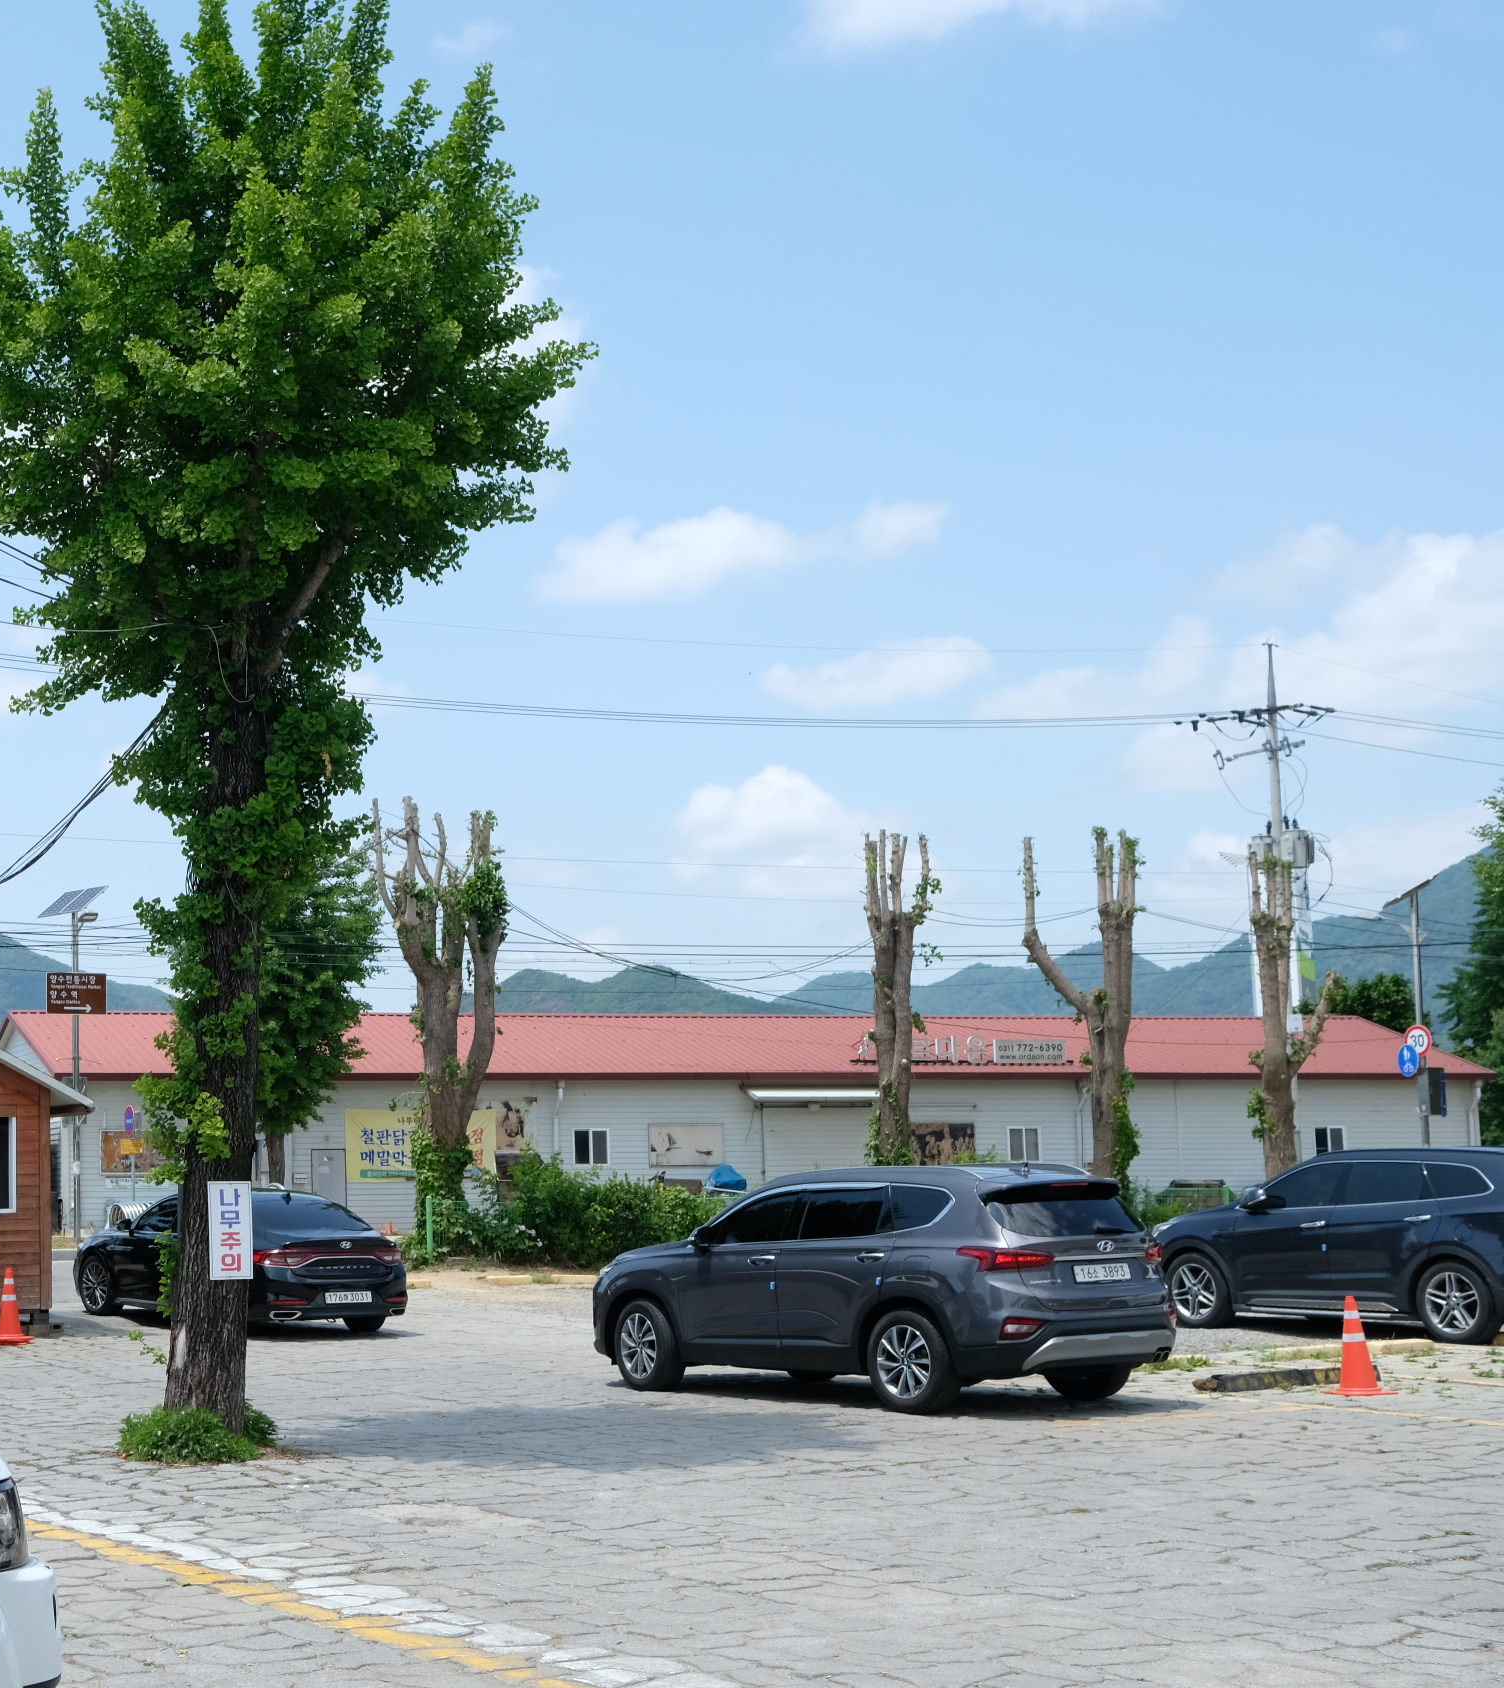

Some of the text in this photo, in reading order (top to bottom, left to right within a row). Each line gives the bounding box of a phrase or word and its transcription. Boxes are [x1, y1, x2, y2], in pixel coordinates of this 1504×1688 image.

[49, 975, 96, 984] 양수전통시장
[1410, 1034, 1425, 1047] 30
[998, 1043, 1063, 1052] 031) 772-6390
[360, 1128, 413, 1146] 철판닭
[360, 1149, 412, 1167] 메밀막
[1101, 1266, 1126, 1278] 3893
